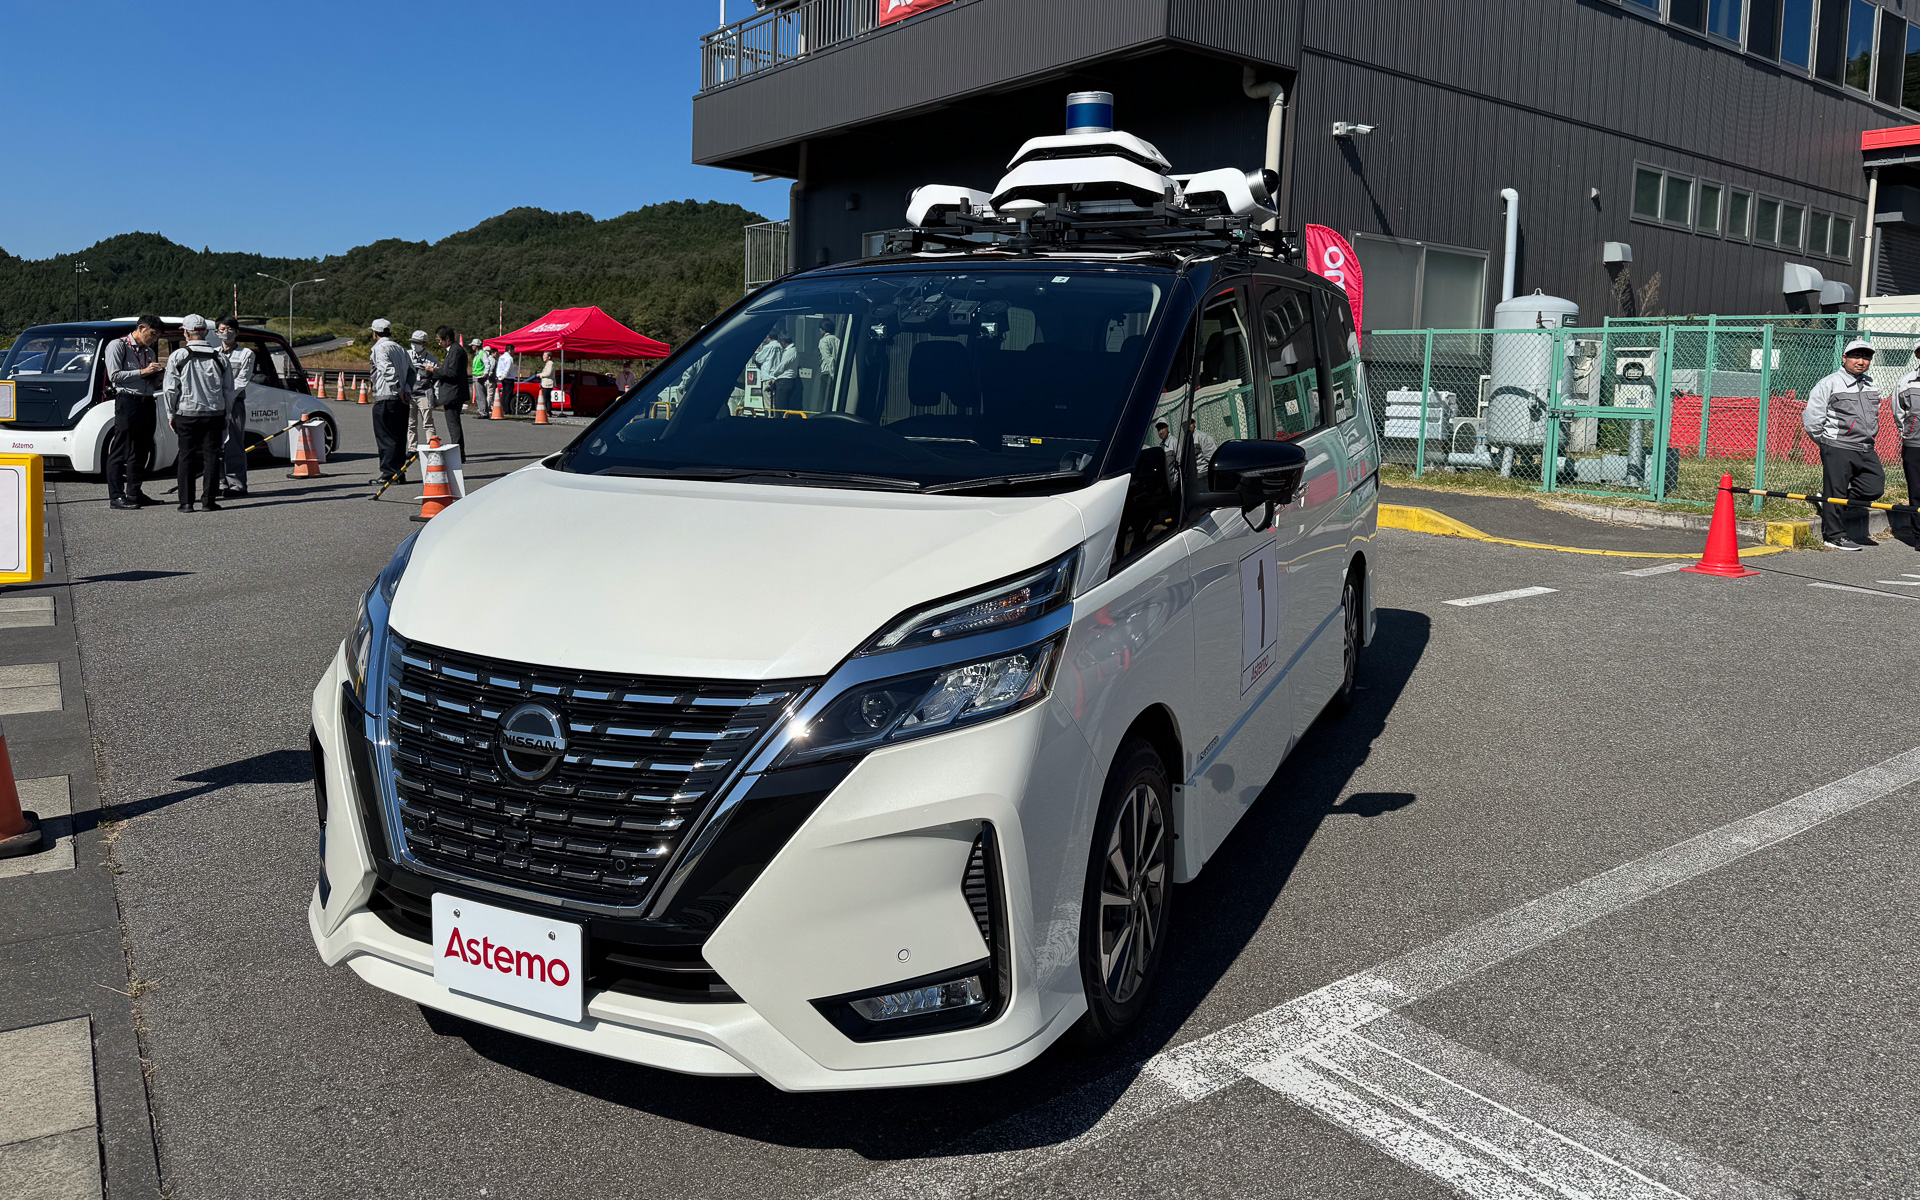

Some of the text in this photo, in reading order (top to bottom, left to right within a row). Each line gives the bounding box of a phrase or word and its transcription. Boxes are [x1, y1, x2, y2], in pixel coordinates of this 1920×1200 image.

[554, 391, 559, 401] 8
[1257, 559, 1266, 649] 1
[1250, 654, 1269, 682] Astemo
[502, 734, 556, 751] NISSAN
[444, 927, 570, 986] Astemo
